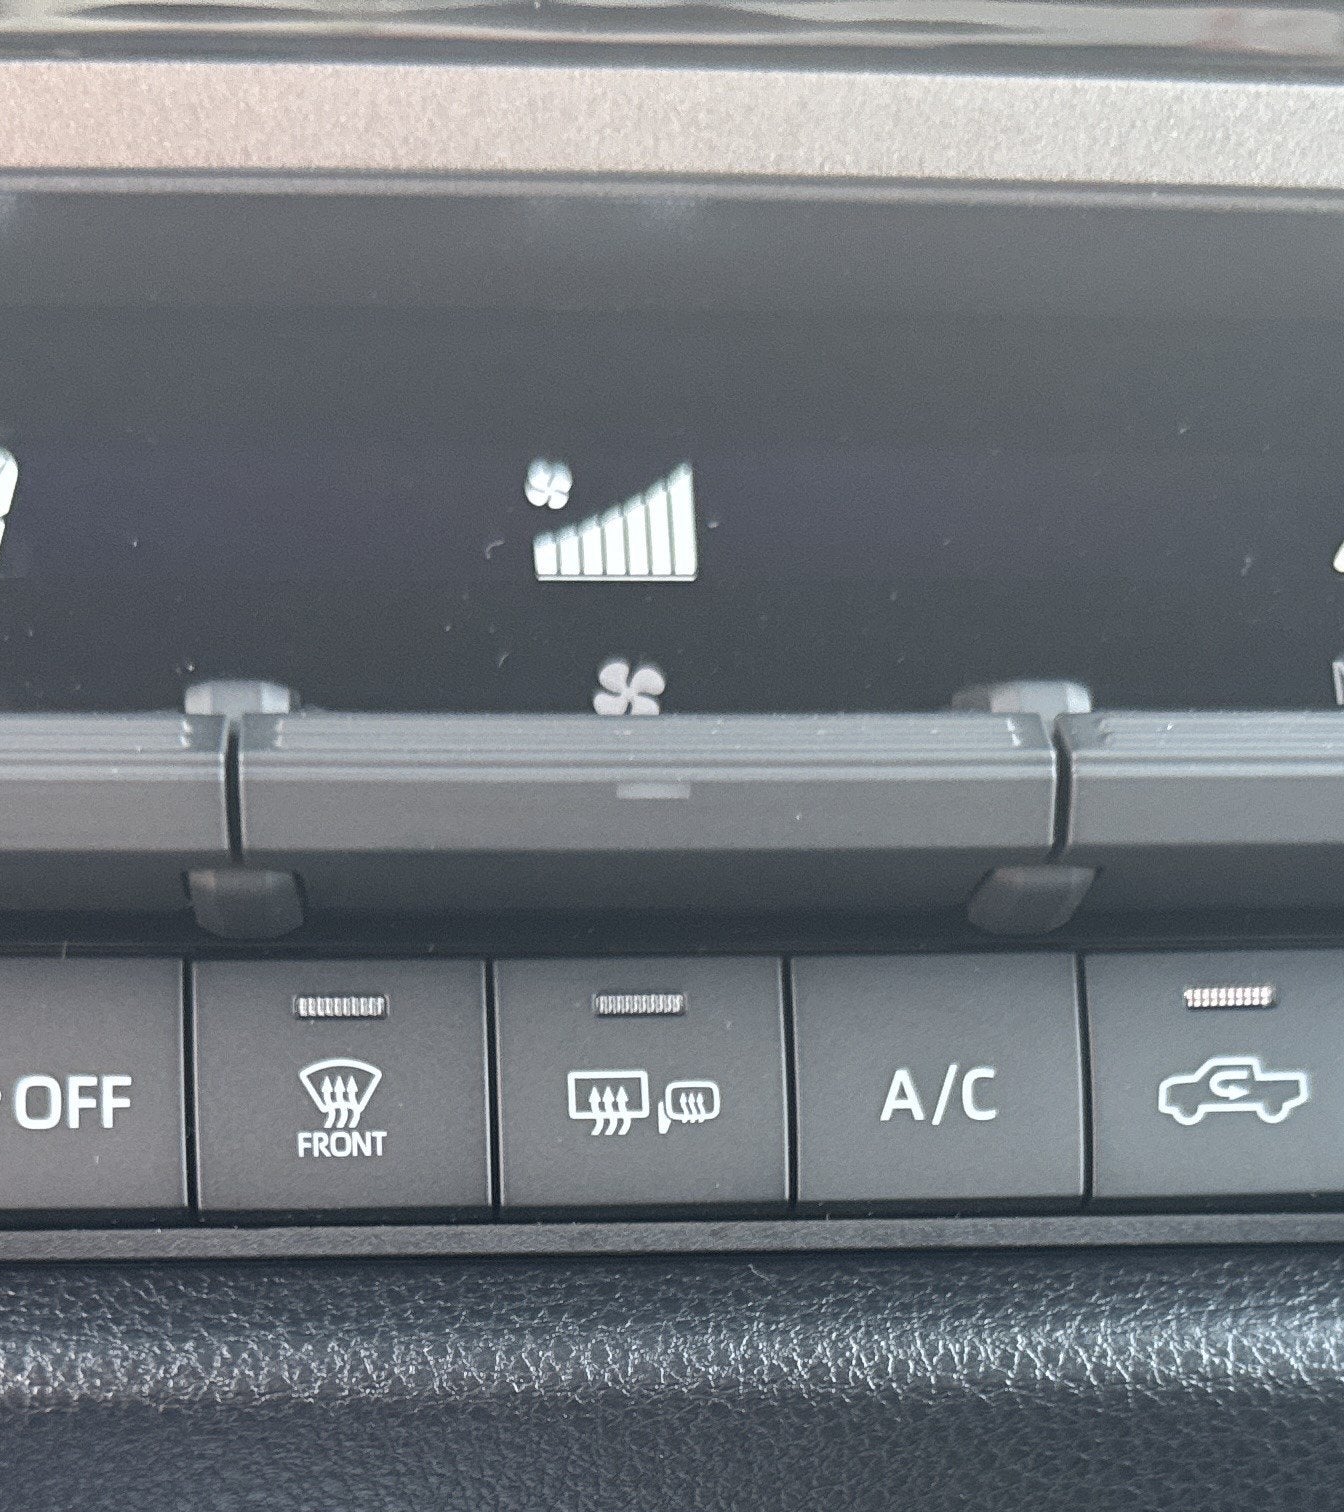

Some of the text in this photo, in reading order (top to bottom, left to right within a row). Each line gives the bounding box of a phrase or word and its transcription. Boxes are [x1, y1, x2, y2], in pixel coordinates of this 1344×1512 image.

[12, 1073, 133, 1130] OFF
[879, 1062, 999, 1126] A/C
[296, 1130, 389, 1159] FRONT
